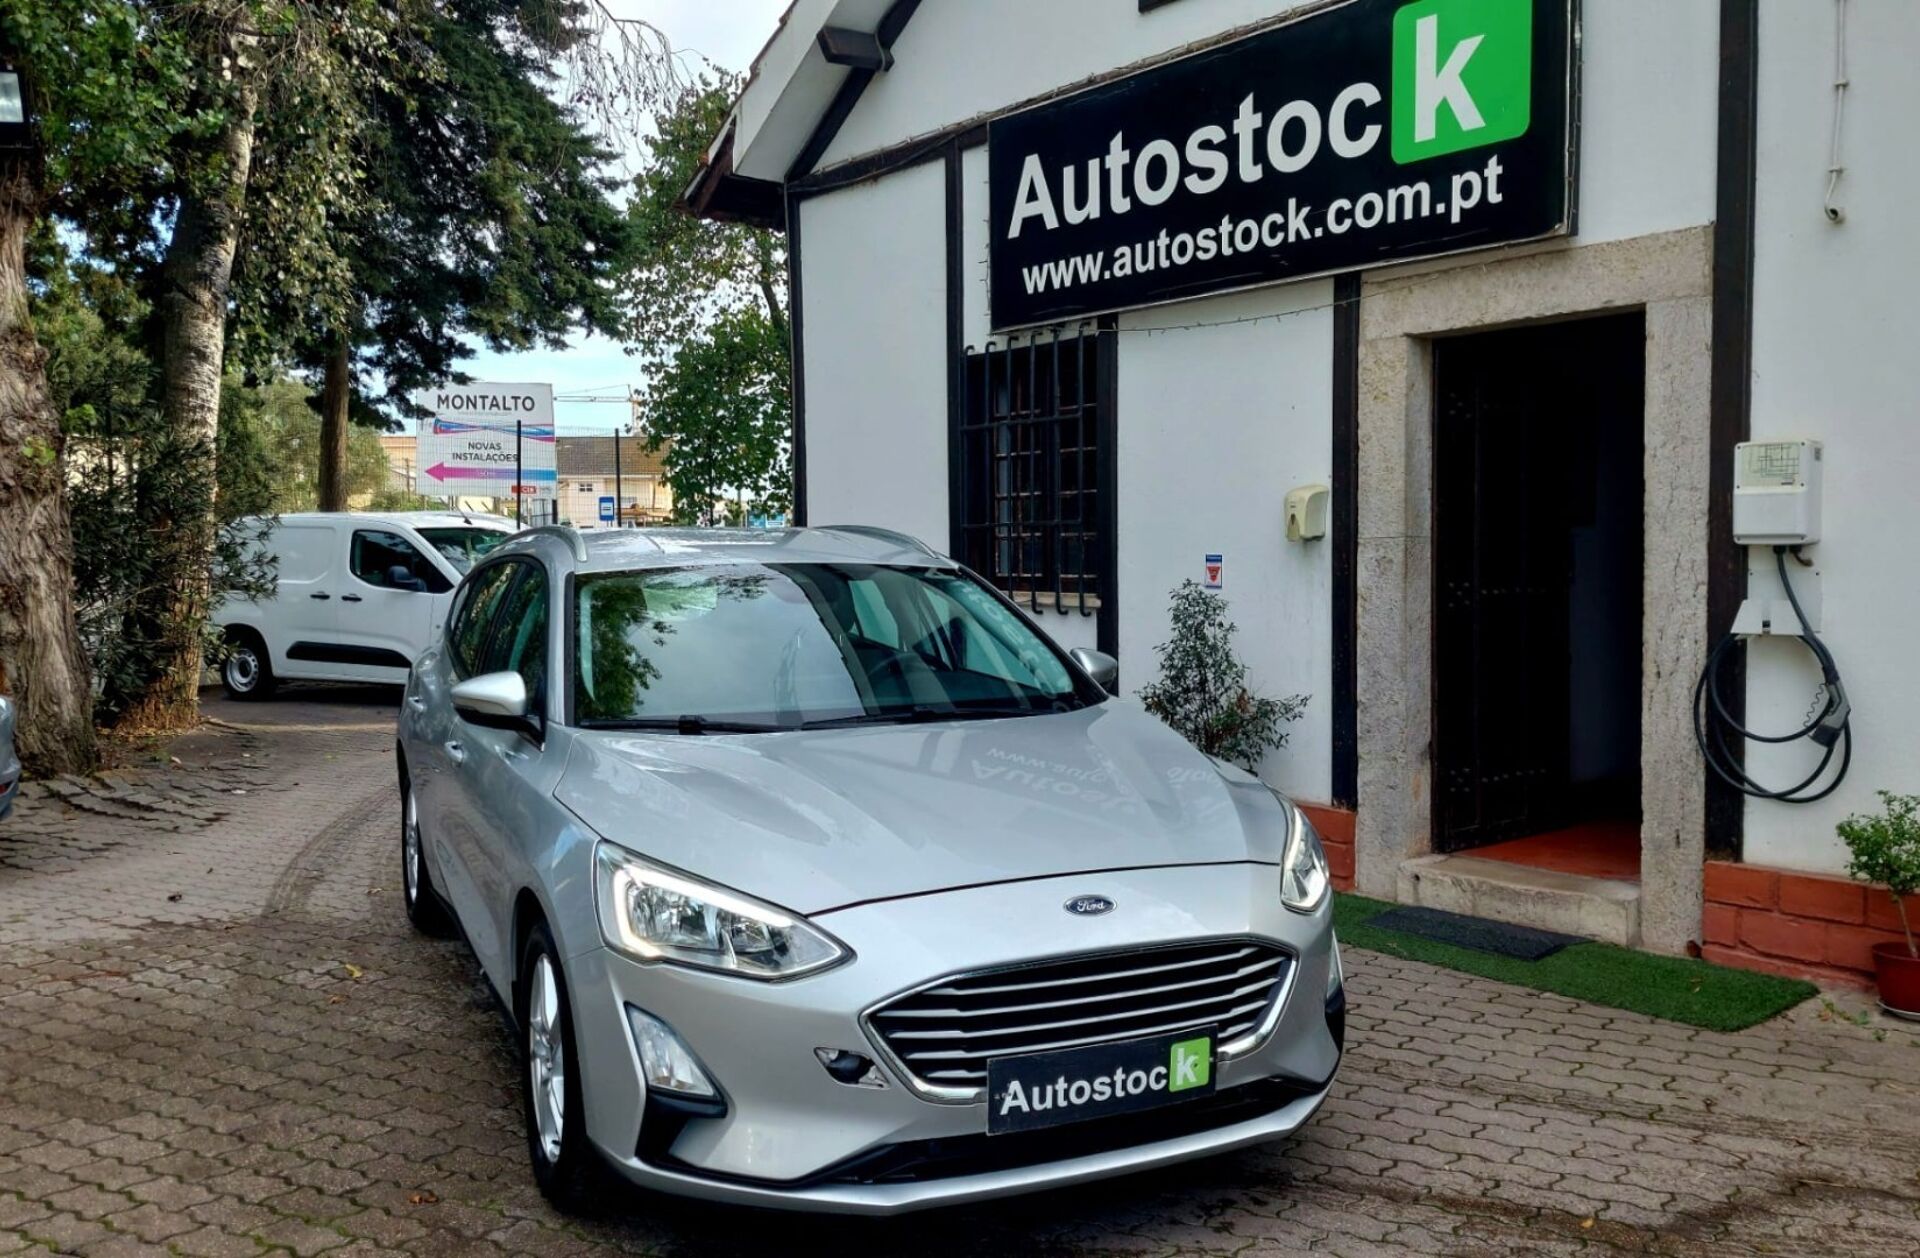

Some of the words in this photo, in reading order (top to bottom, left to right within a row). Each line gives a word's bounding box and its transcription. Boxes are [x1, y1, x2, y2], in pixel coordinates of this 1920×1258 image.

[1006, 13, 1487, 241] Autostock
[1021, 153, 1504, 295] www.autostock.com.pt
[437, 394, 535, 411] MONTALTO
[468, 442, 502, 450] NOVAS
[1077, 900, 1105, 912] Ford
[1000, 1047, 1199, 1116] Autostock
